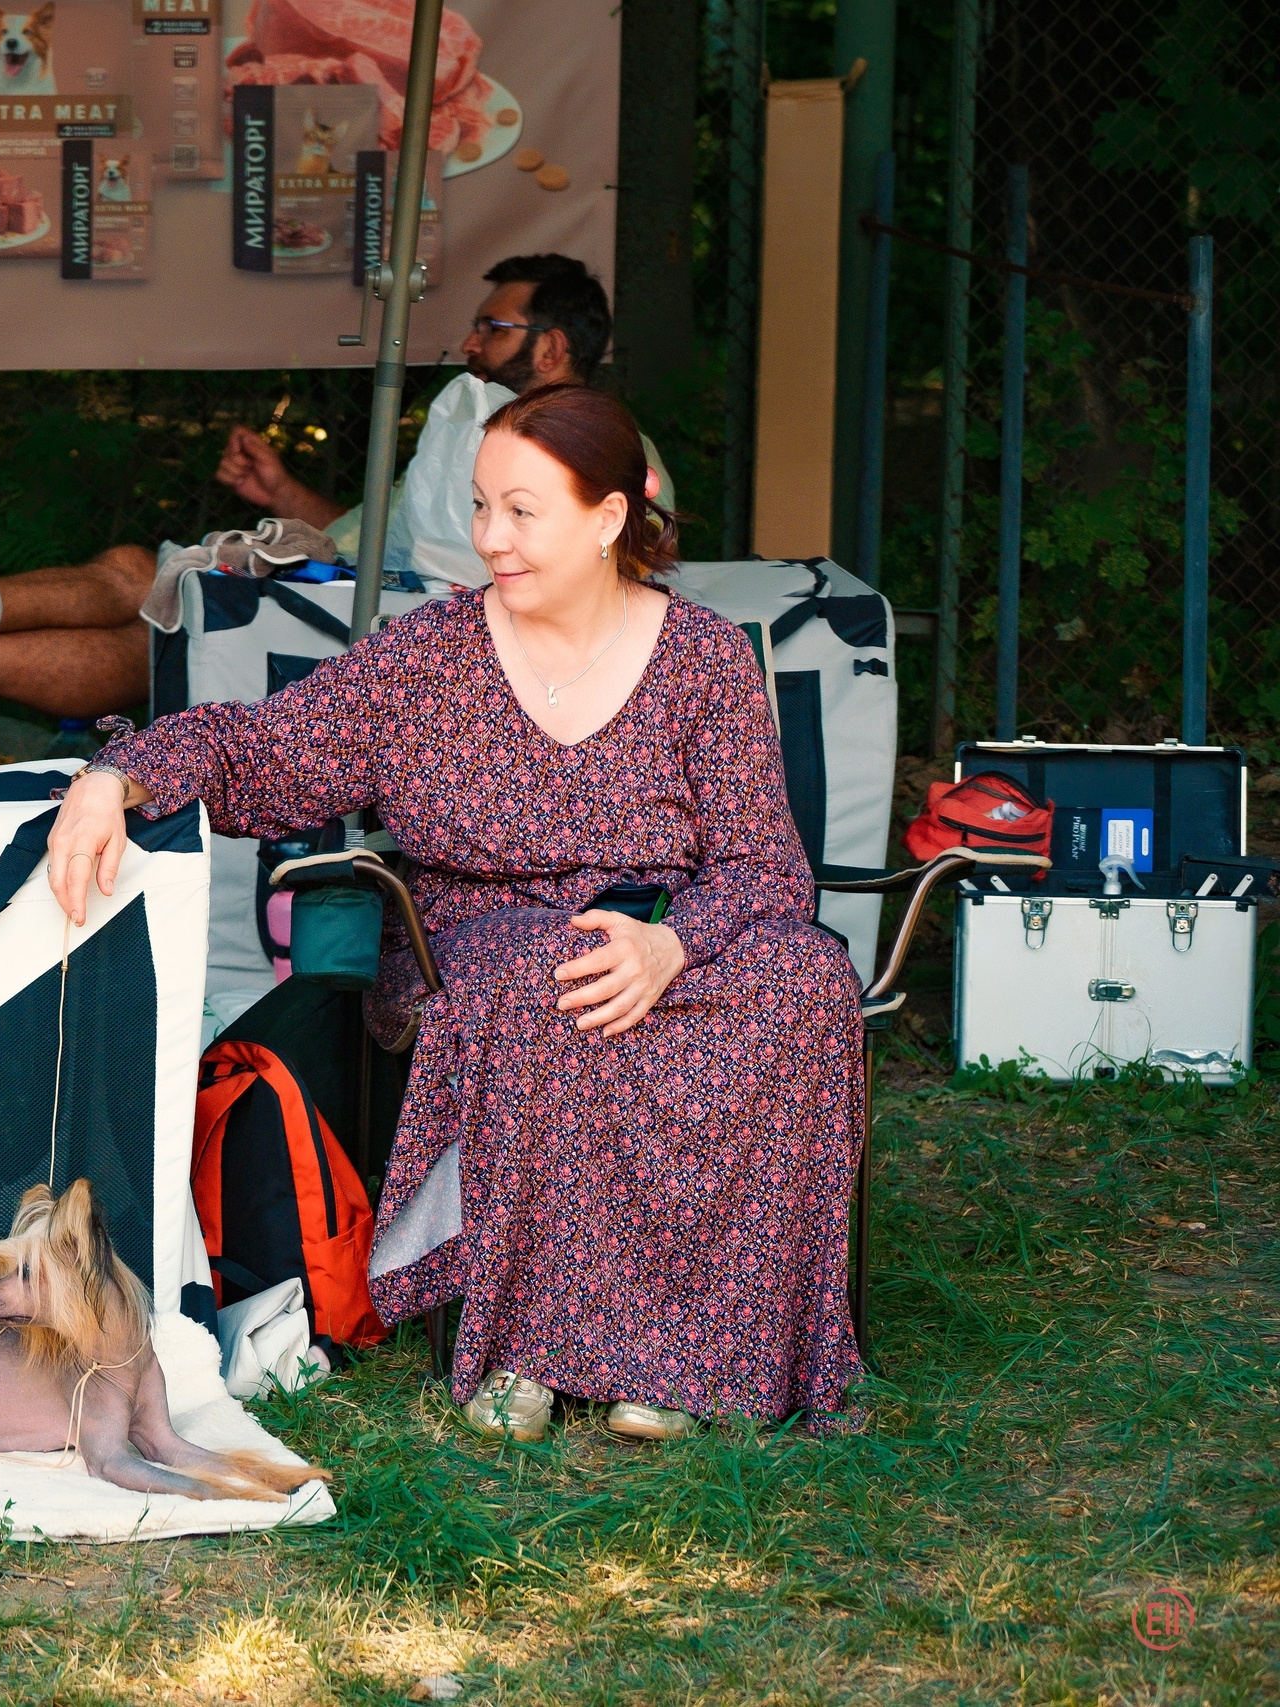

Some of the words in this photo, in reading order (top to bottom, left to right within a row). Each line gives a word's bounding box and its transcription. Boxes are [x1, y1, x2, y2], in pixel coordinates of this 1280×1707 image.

[55, 104, 117, 120] MEAT
[72, 162, 90, 264] МИРАТОРГ
[243, 114, 267, 249] МИРАТОРГ
[328, 178, 357, 188] MEA
[363, 173, 382, 270] МИРАТОРГ
